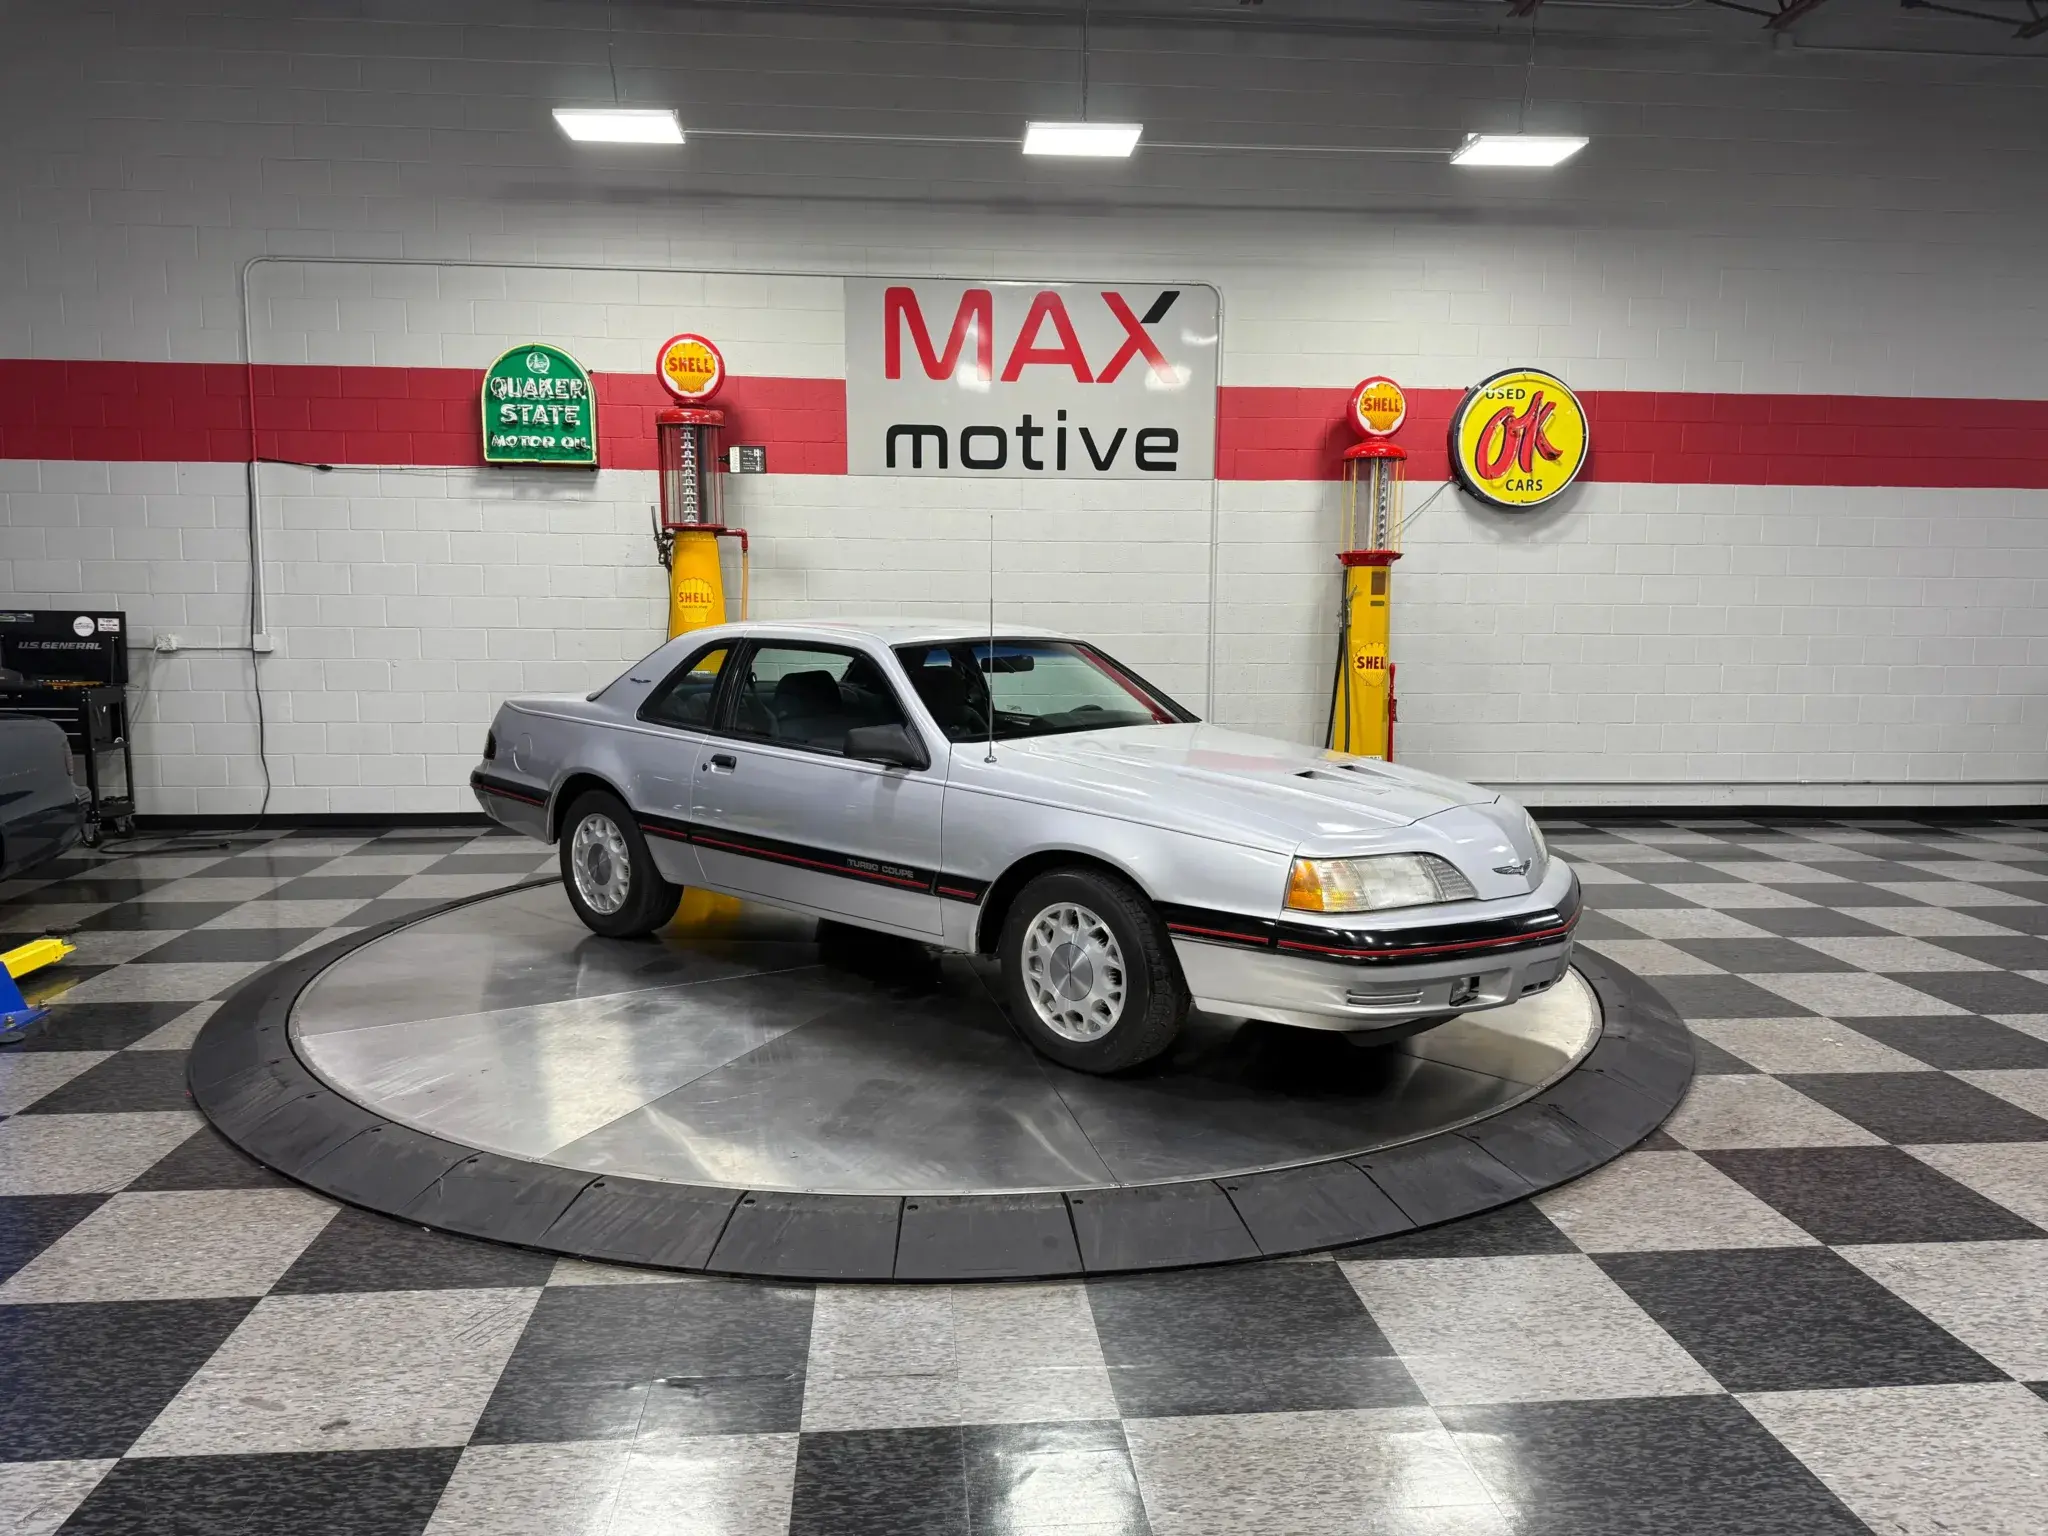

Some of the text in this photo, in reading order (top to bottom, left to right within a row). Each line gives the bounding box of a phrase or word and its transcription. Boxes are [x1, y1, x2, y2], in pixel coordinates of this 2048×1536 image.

[884, 286, 1180, 383] MAX
[669, 356, 712, 374] SHELL
[490, 376, 588, 400] QUAKER
[1485, 388, 1526, 400] USED
[1363, 397, 1400, 413] SHELL
[500, 403, 581, 426] STATE
[491, 434, 591, 450] MOTOR OIL
[886, 409, 1179, 472] motive
[1474, 390, 1564, 480] OK
[1505, 478, 1543, 492] CARS
[679, 591, 712, 603] SHELL
[41, 641, 102, 650] GENERAL
[1356, 656, 1387, 670] SHEL
[846, 858, 914, 879] TURBO COUPE
